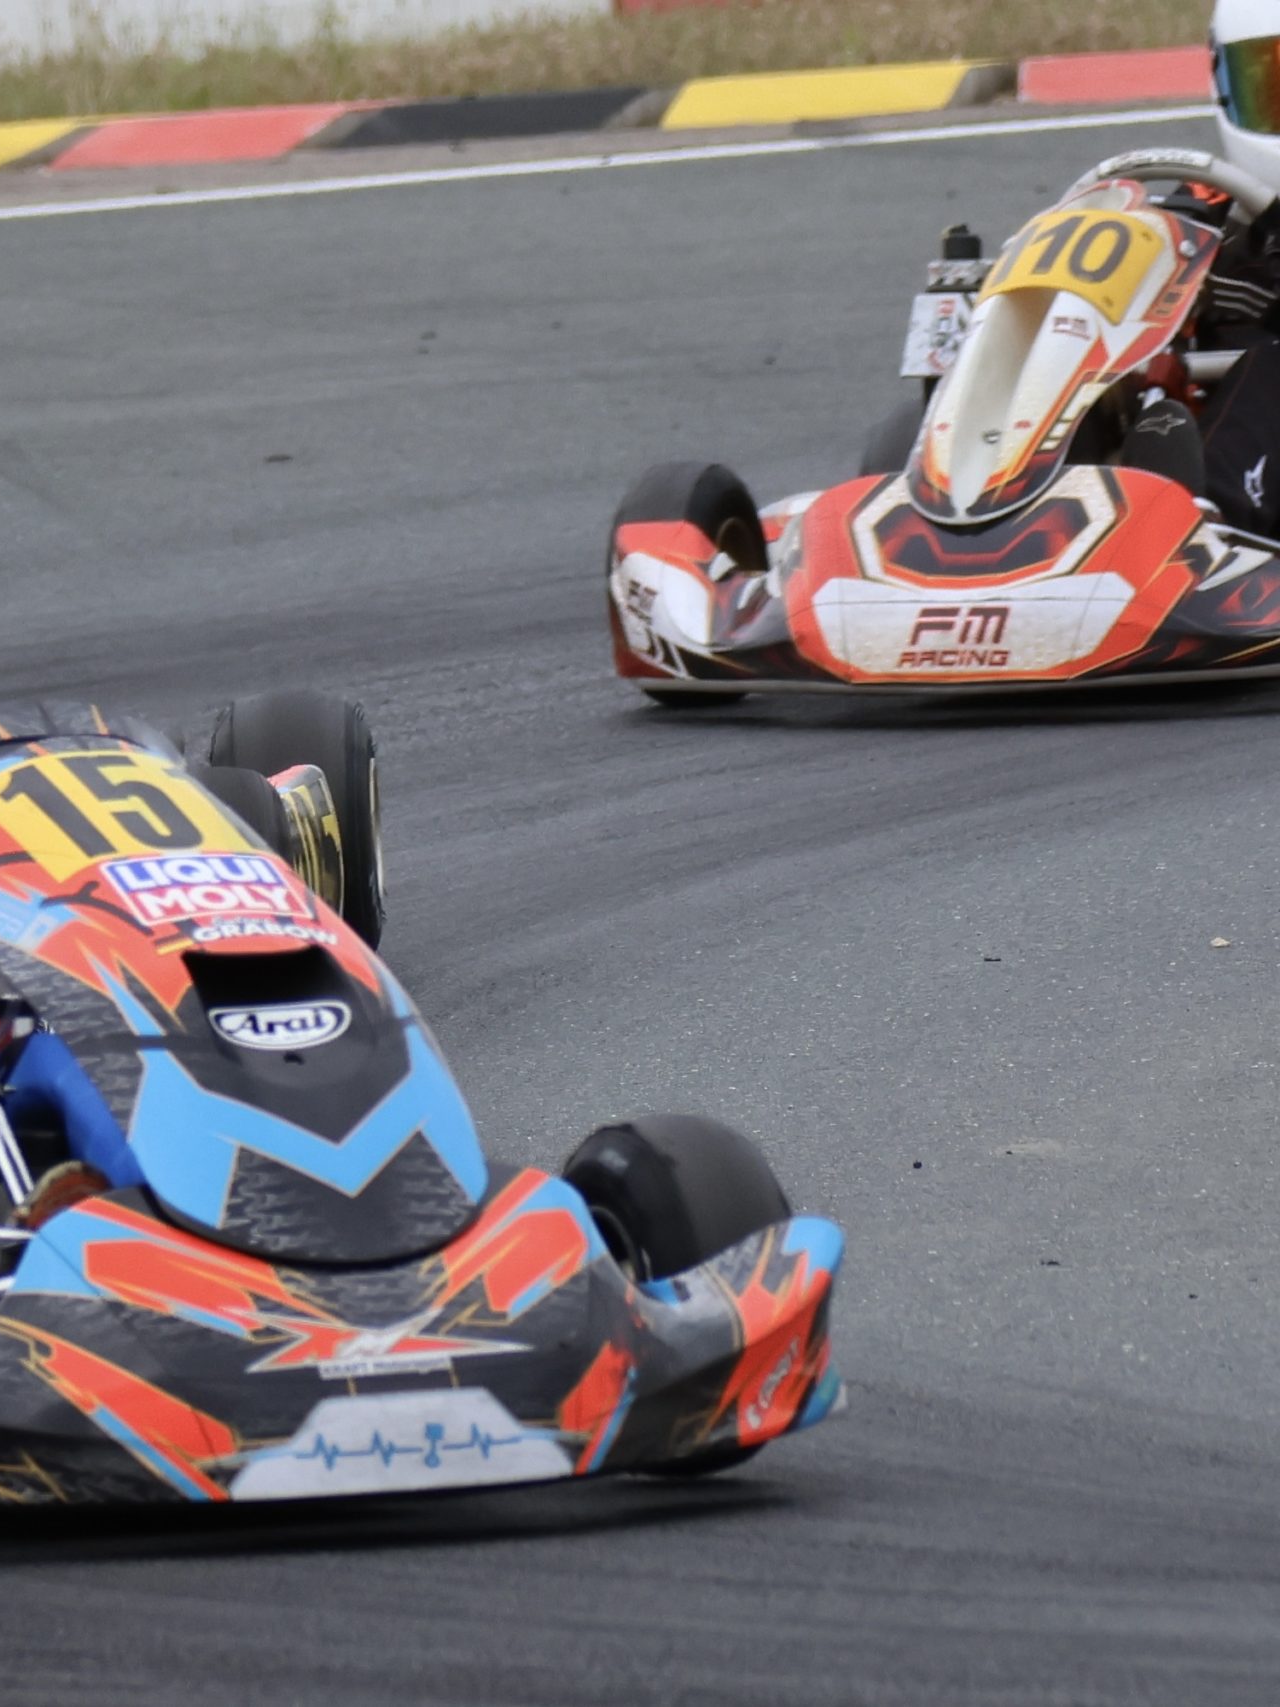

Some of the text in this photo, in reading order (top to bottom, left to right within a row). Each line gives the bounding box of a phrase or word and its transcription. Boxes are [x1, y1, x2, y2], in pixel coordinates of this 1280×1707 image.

[910, 606, 1010, 646] FM
[897, 649, 1011, 669] RACING
[114, 857, 276, 890] LIQUI
[132, 885, 296, 919] MOLY
[193, 919, 338, 945] GRABOW
[225, 1007, 326, 1037] Arai
